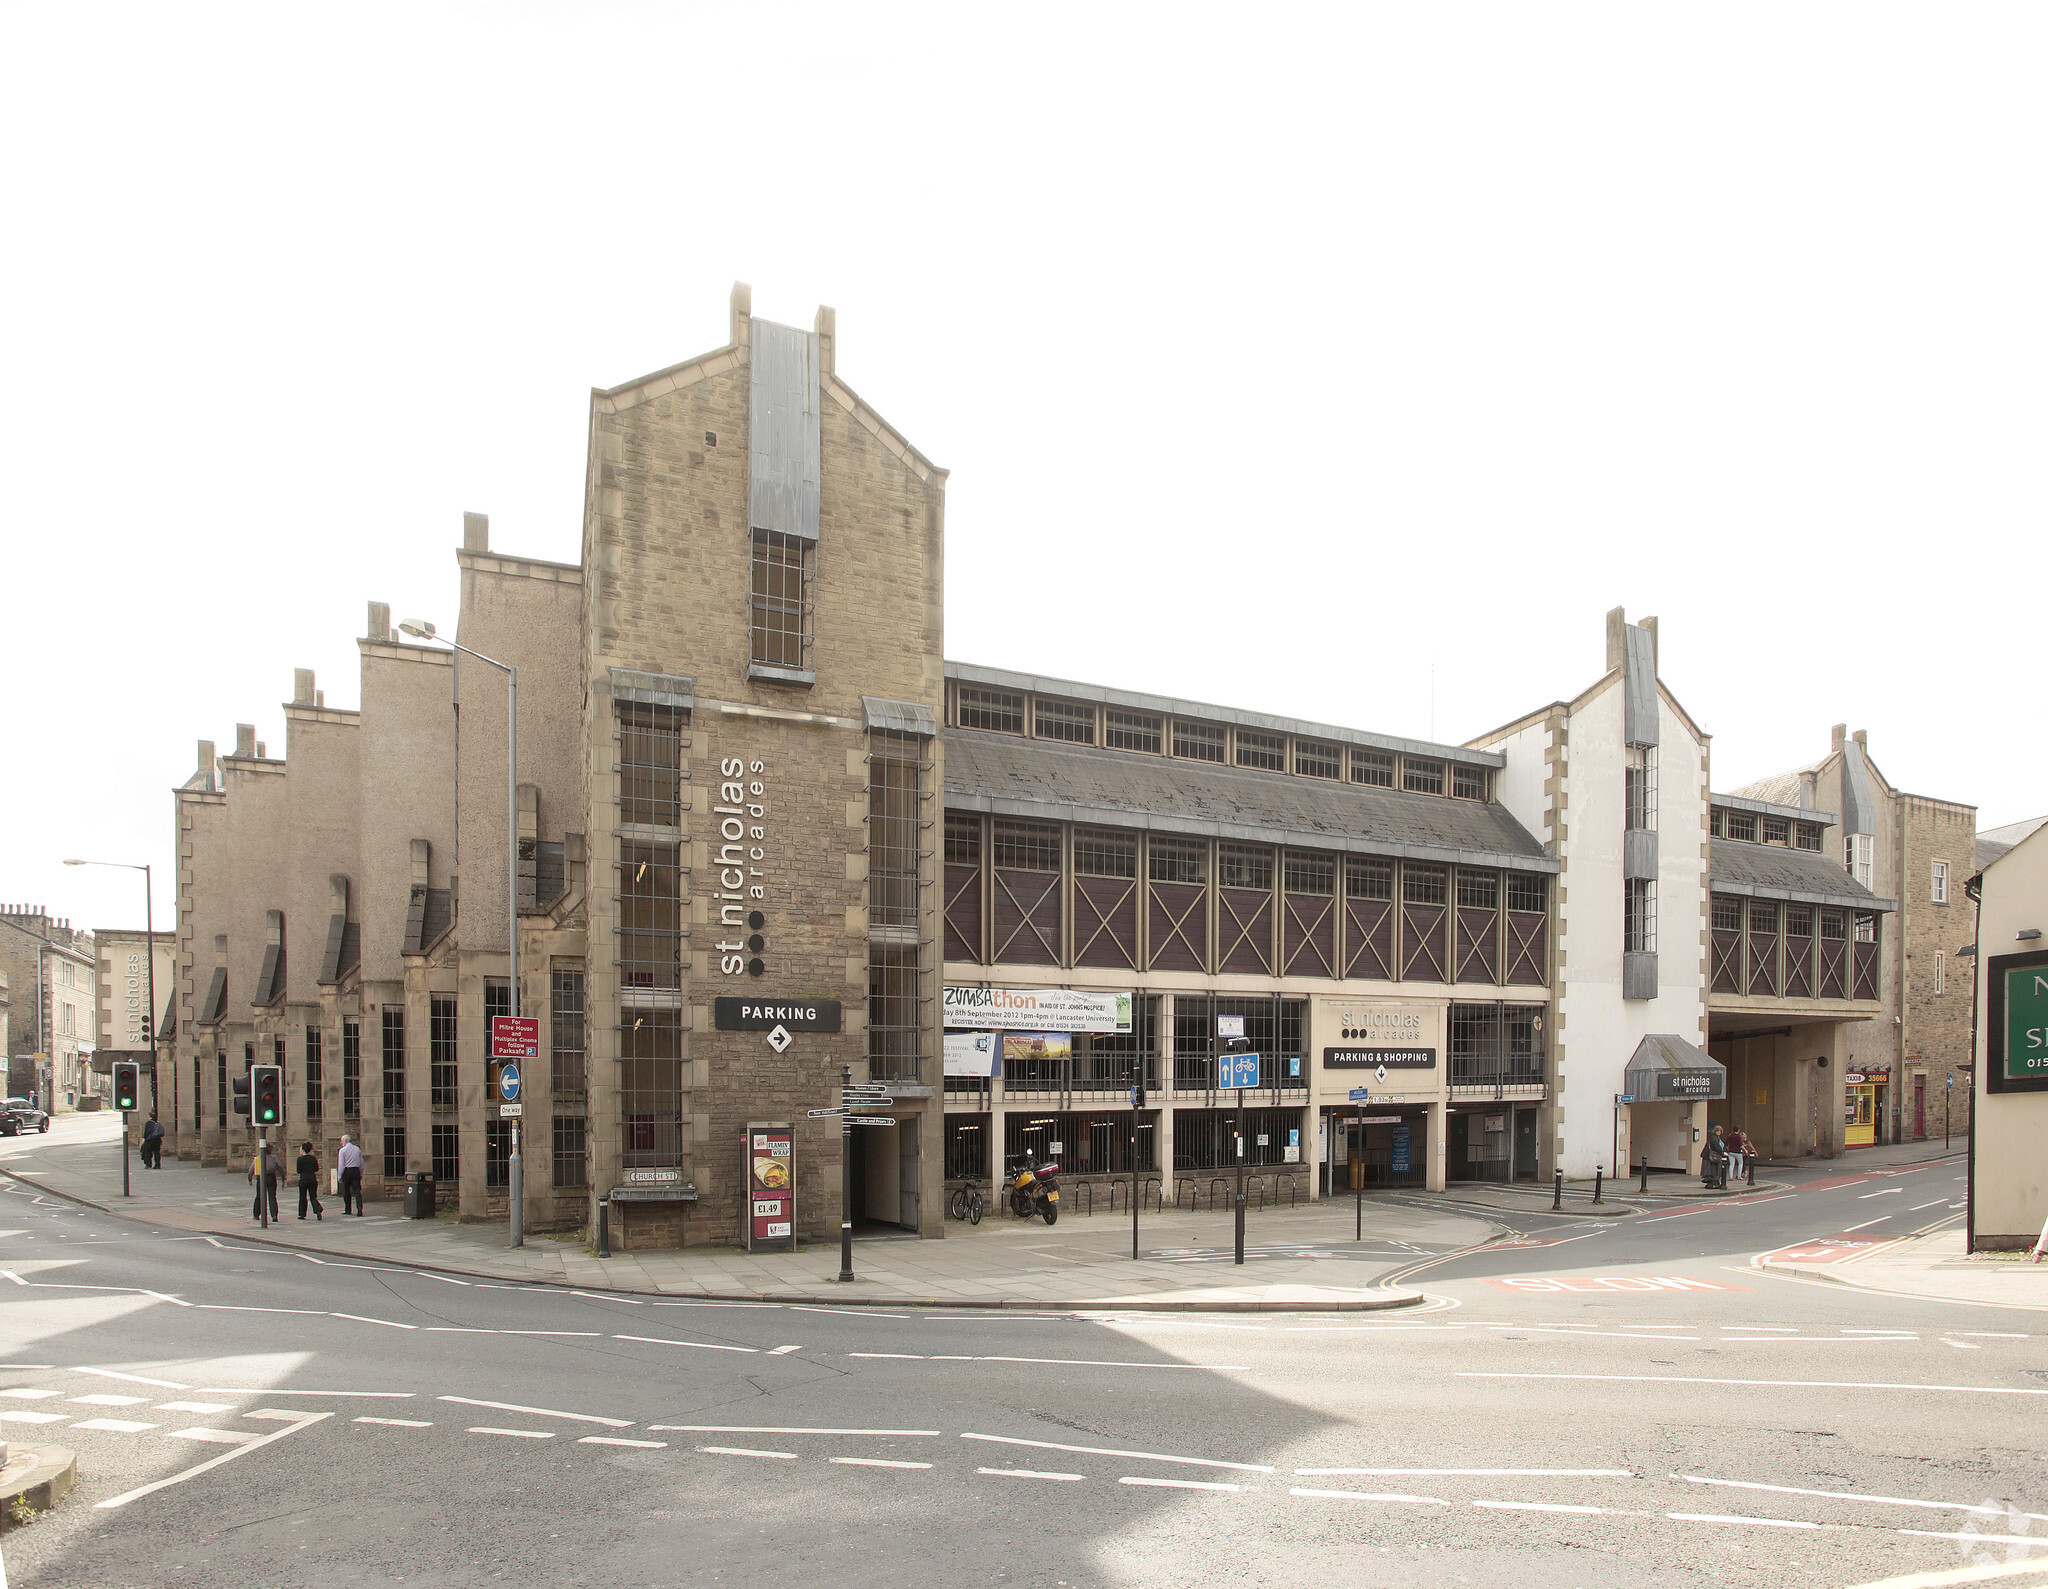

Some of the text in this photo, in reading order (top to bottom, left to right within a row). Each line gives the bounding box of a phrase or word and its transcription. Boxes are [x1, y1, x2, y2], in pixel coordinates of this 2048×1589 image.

[746, 760, 764, 899] arcades
[714, 758, 744, 975] st nicholas
[142, 955, 150, 1011] arcades
[124, 954, 140, 1042] st nicholas
[742, 1006, 817, 1020] PARKING
[967, 1010, 1002, 1018] September
[1020, 1012, 1049, 1020] 1pm-4pm
[1085, 1015, 1115, 1023] University
[1342, 1010, 1420, 1027] st nicholas
[1370, 1029, 1420, 1039] arcades
[499, 1047, 525, 1055] Parksafe
[1334, 1052, 1428, 1062] PARKING & SHOPPING
[1672, 1076, 1710, 1087] st nicholas
[512, 1107, 520, 1115] way
[758, 1204, 778, 1213] £1.49
[1501, 1277, 1727, 1291] SLOW
